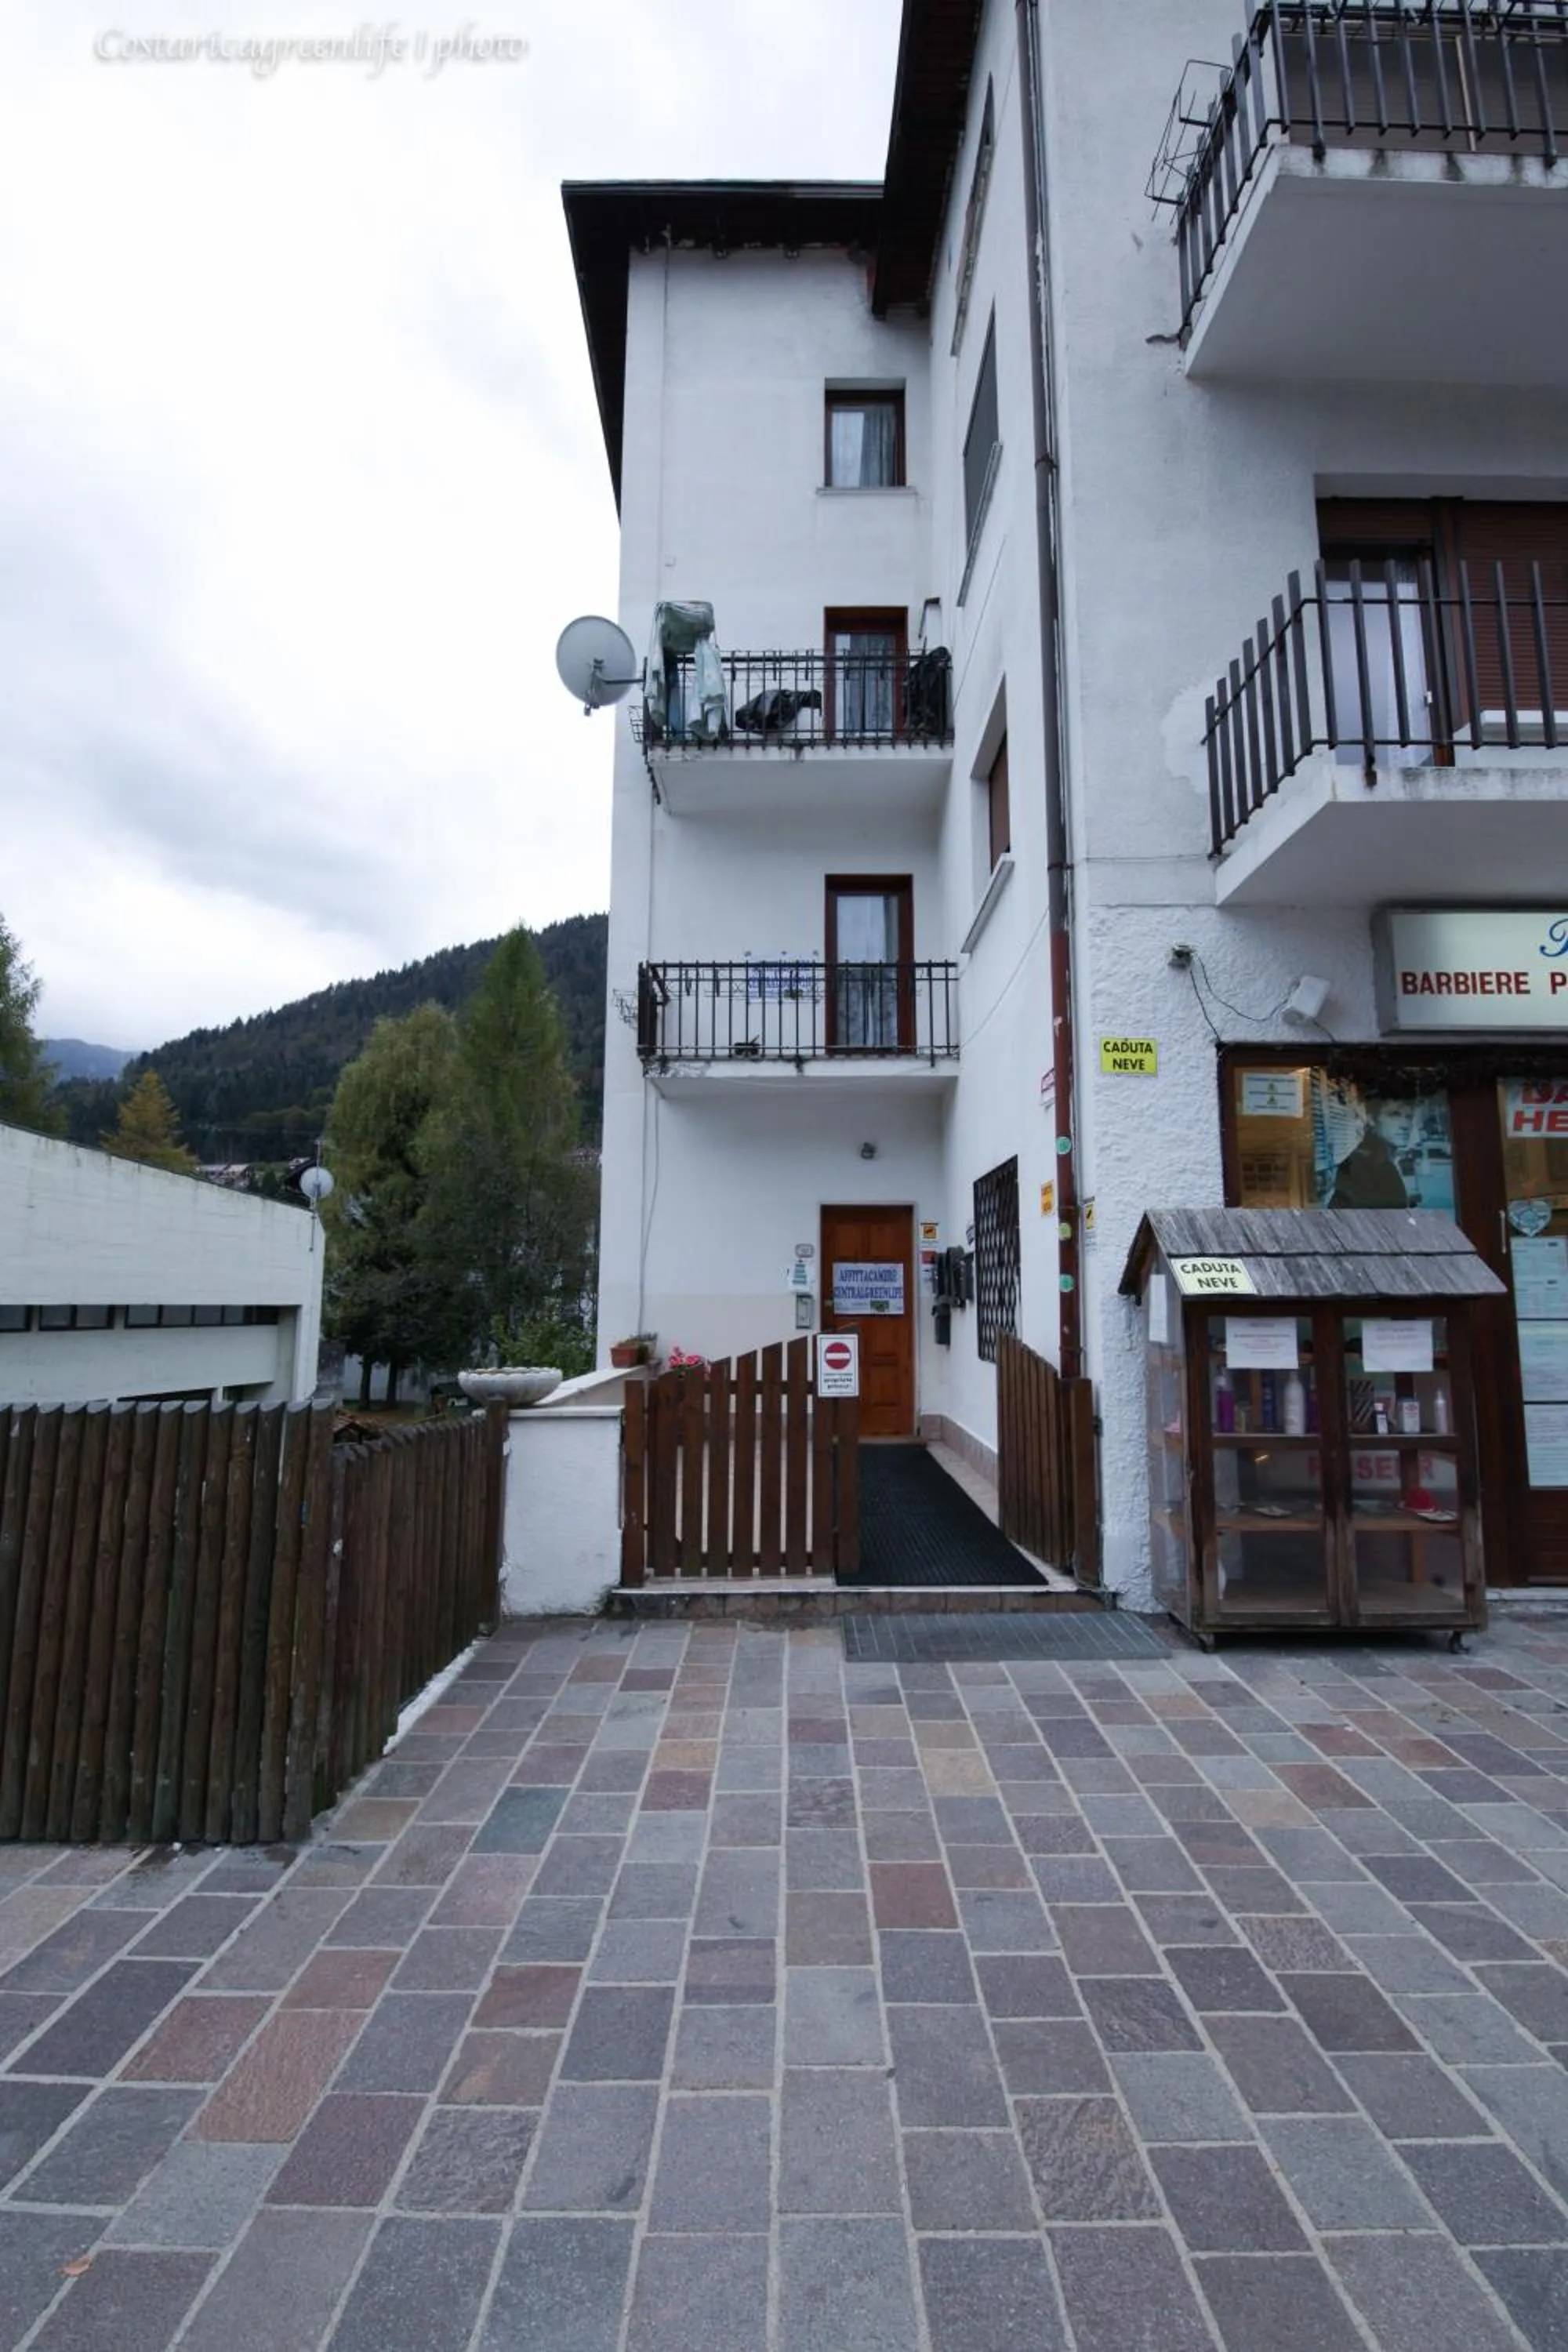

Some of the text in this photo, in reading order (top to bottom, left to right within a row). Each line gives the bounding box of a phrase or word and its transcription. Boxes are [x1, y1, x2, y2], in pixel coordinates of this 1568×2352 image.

[1401, 971, 1530, 995] BARBIERE
[1103, 1041, 1152, 1054] CADUTA
[1112, 1058, 1145, 1070] NEVE
[1181, 1262, 1242, 1274] CADUTA
[1198, 1277, 1238, 1288] NEVE
